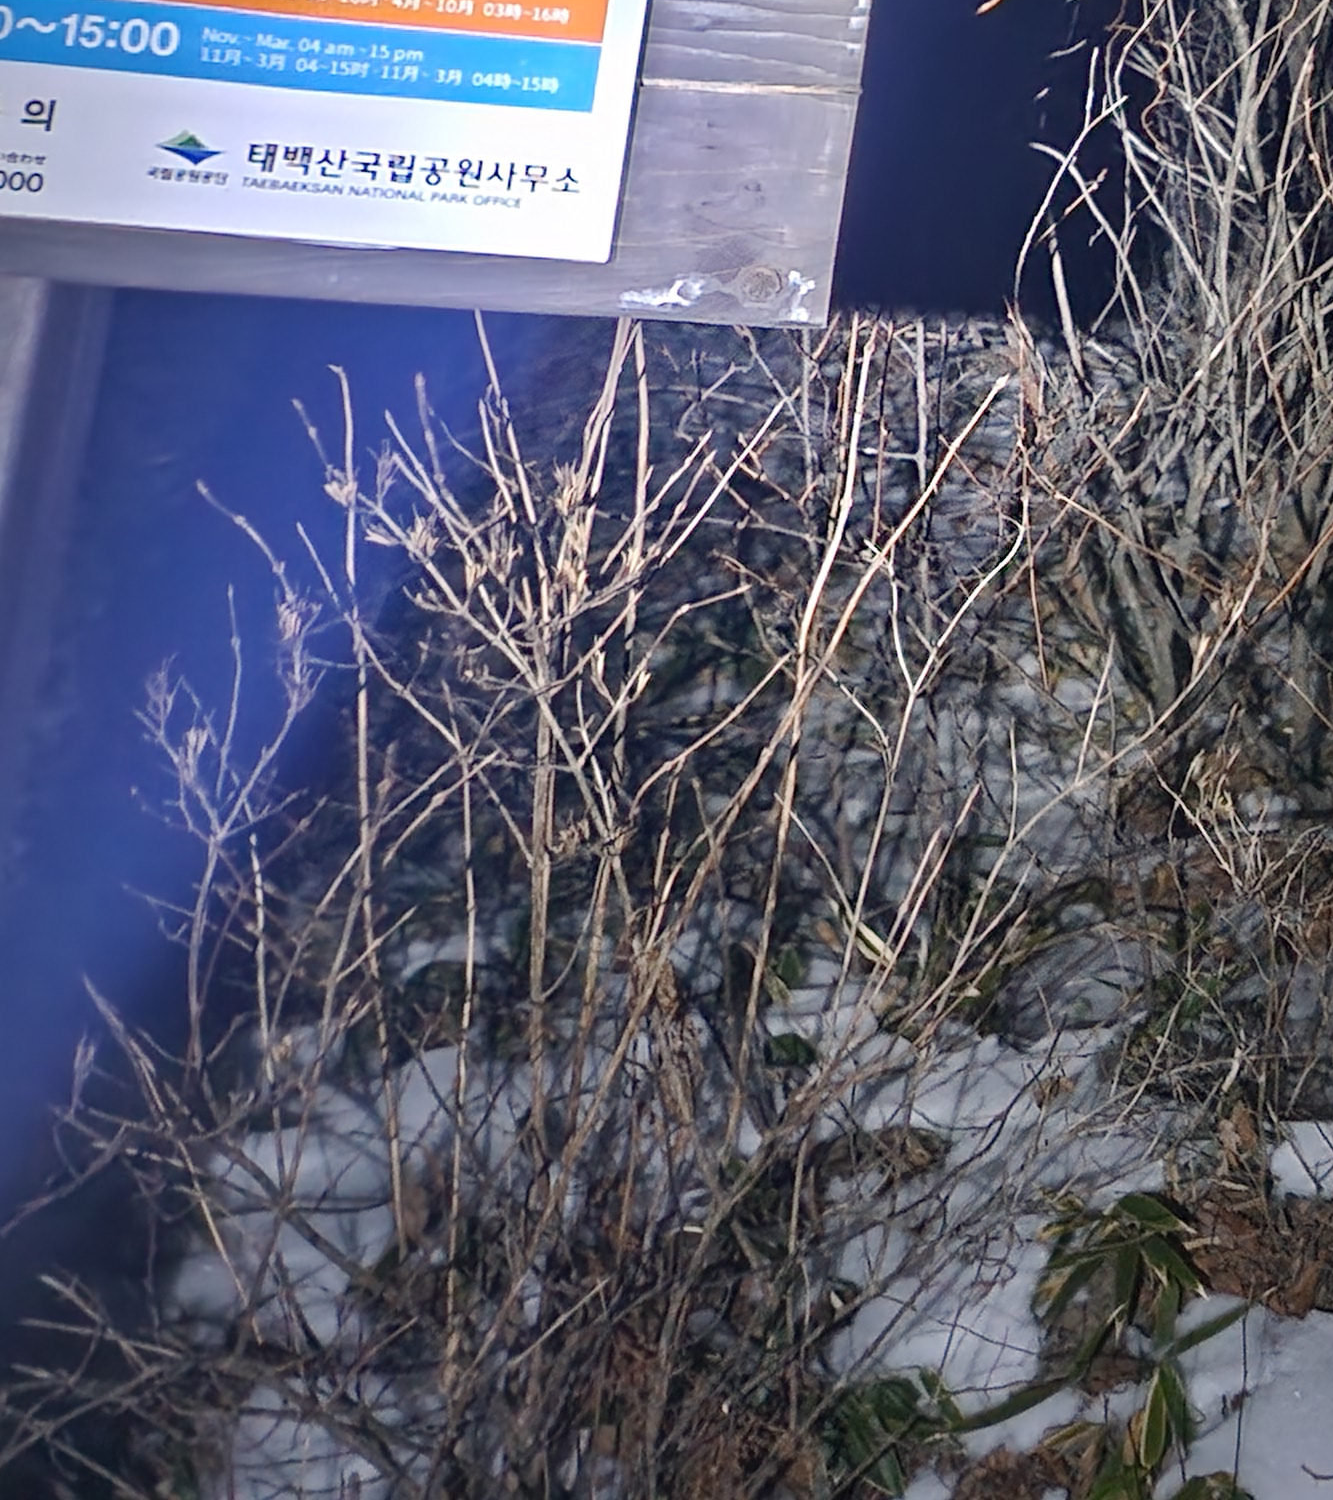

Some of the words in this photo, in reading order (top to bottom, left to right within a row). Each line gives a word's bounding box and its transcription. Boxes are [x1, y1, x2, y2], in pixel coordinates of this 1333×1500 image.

[20, 99, 57, 132] 의
[247, 142, 581, 194] 태백산국립공원사무소
[241, 176, 344, 197] TAEBAEKSAN
[349, 185, 426, 203] NATIONAL
[430, 191, 468, 205] PARK
[472, 195, 522, 210] OFFICE
